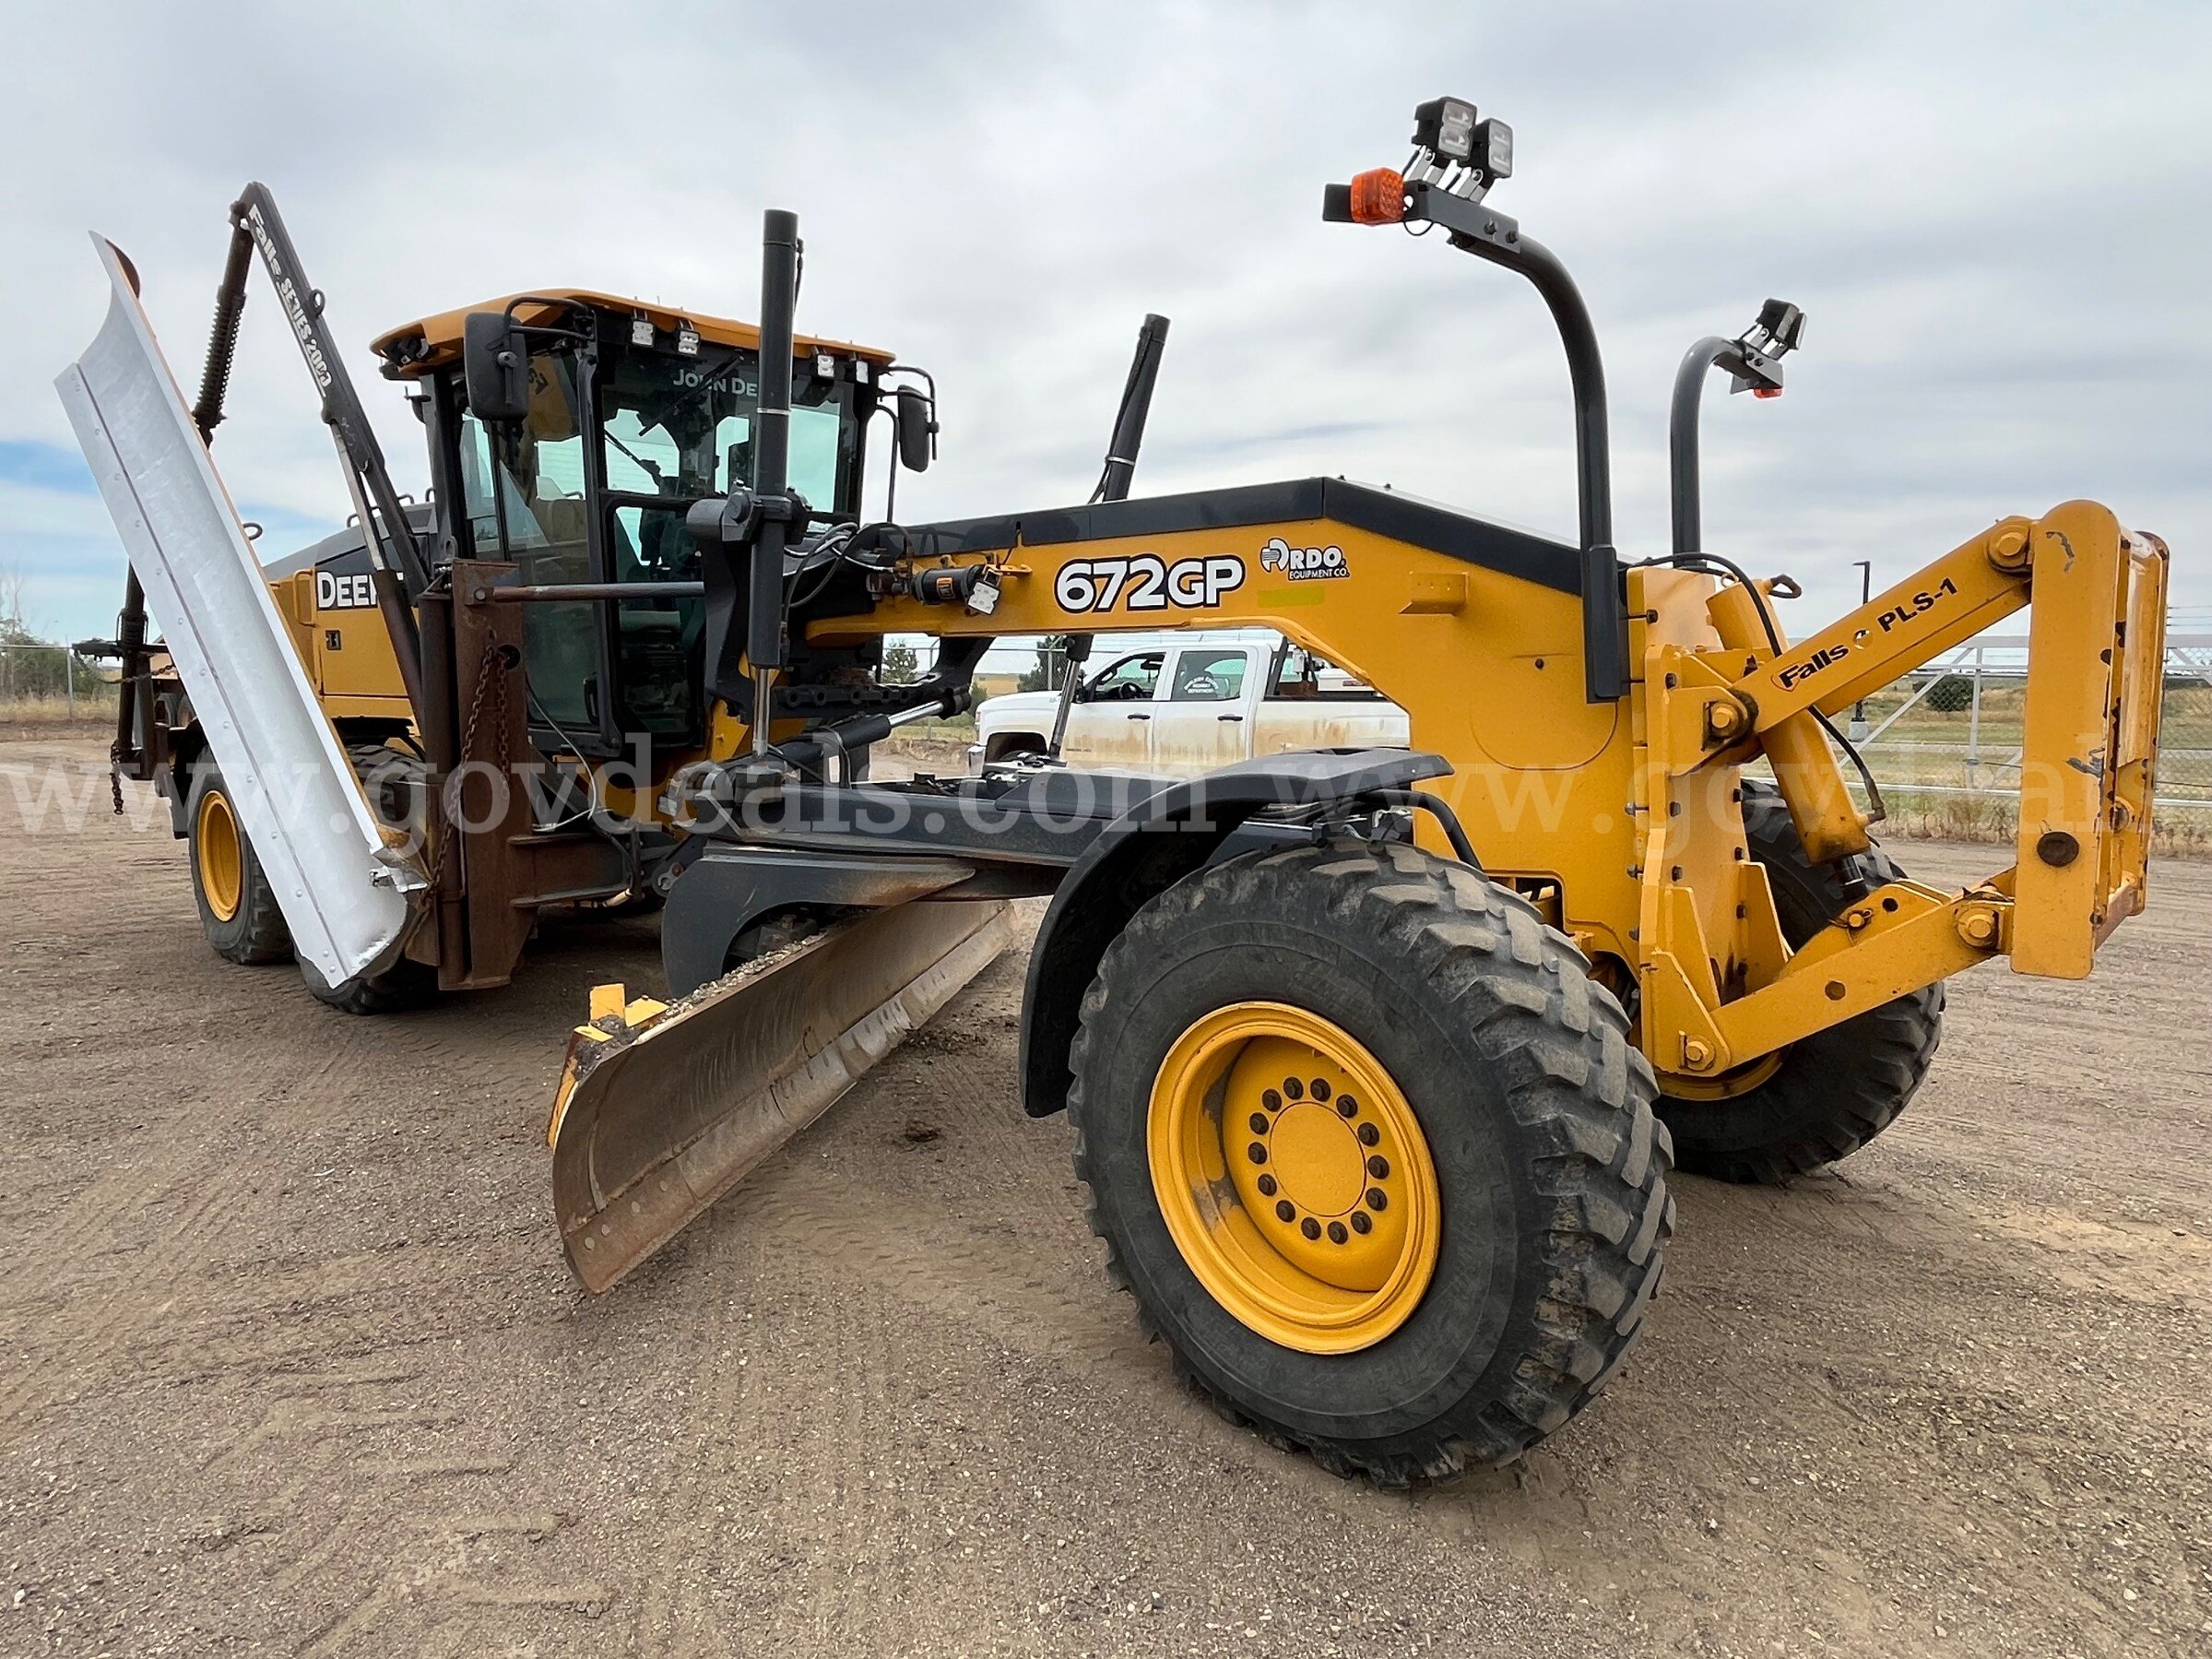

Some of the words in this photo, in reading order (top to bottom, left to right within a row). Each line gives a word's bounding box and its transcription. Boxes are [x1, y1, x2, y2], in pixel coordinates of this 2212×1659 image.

[316, 571, 404, 609] DEE
[1056, 555, 1245, 612] 672GP
[1778, 644, 1850, 689] Falls
[1876, 576, 1958, 633] PLS-1
